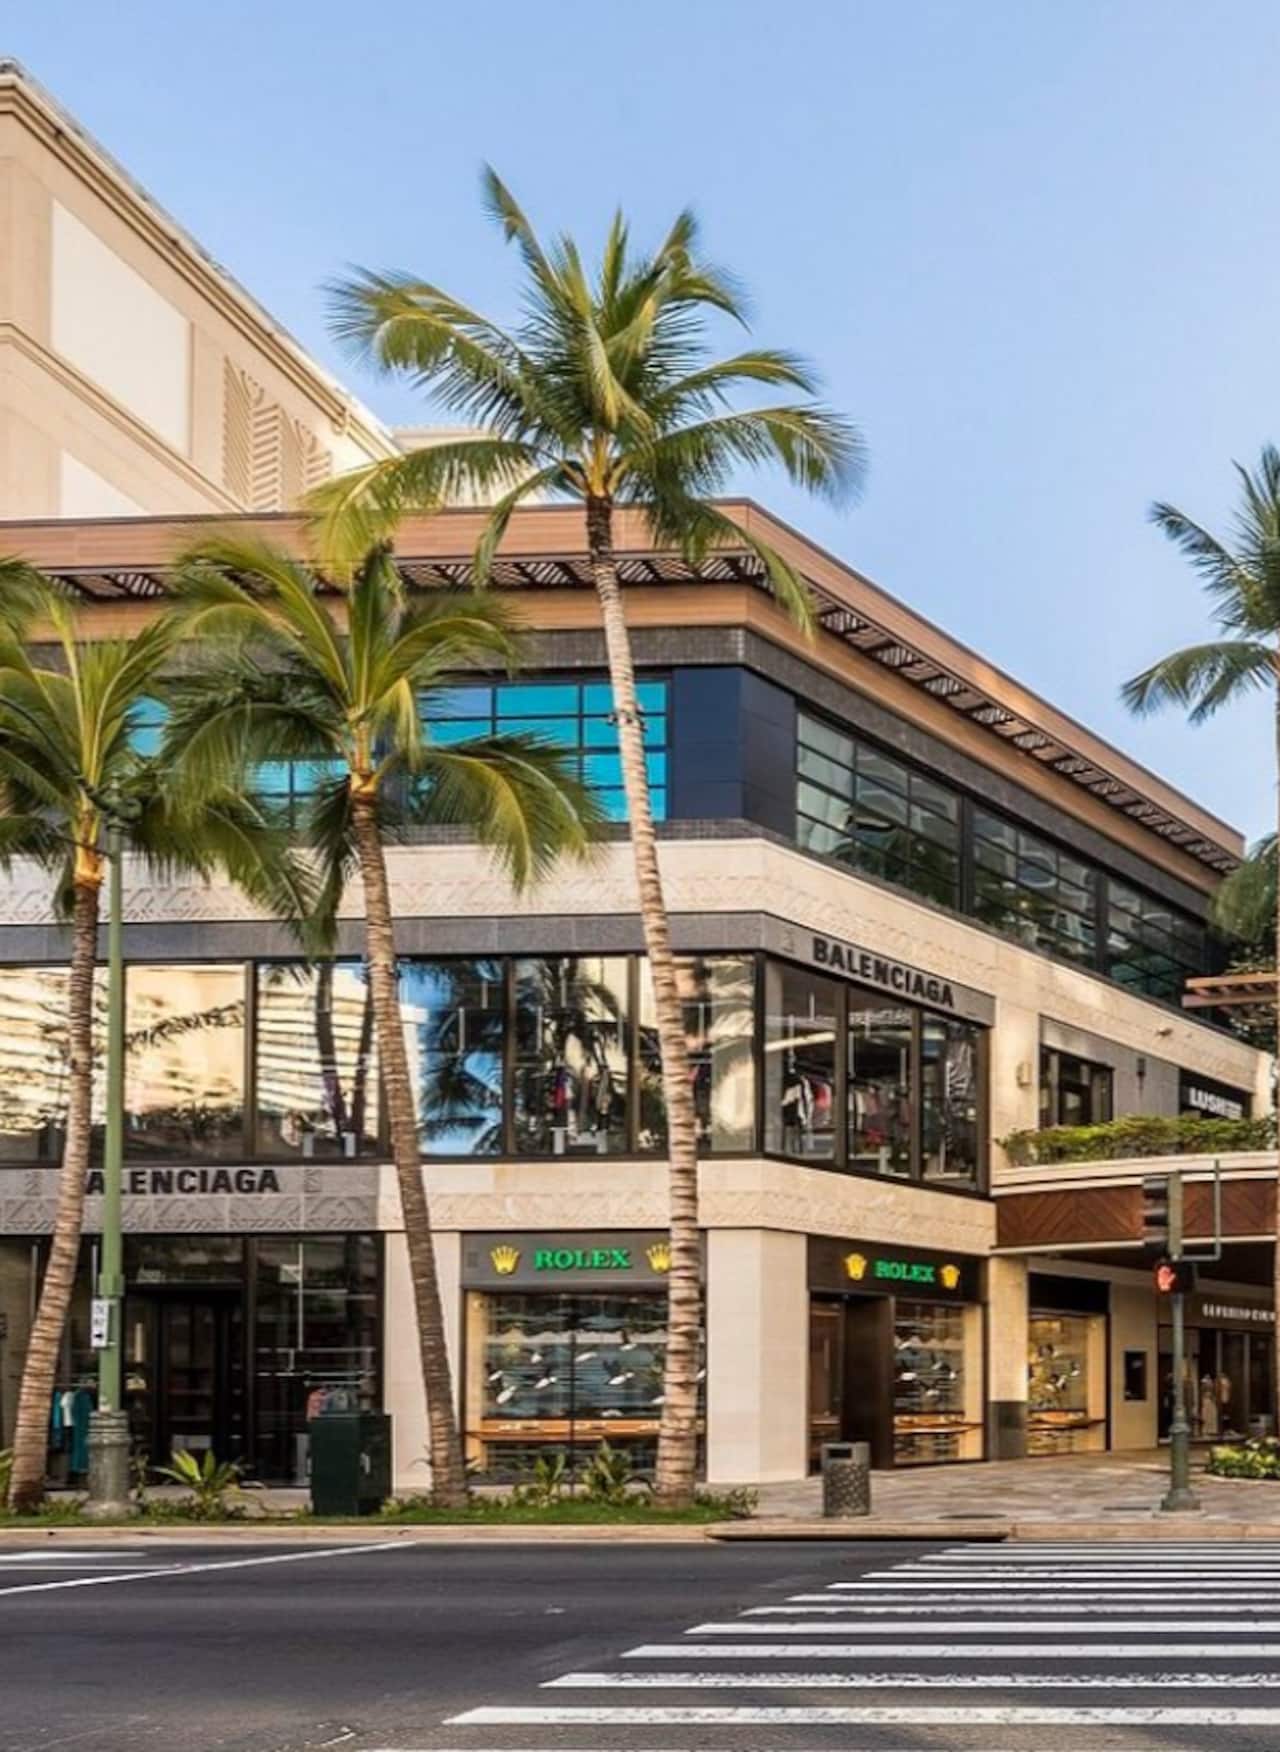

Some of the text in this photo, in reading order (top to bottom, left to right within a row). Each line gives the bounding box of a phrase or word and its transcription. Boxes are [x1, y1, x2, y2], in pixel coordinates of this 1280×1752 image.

[812, 936, 954, 1009] BALENCIAGA
[86, 1169, 281, 1195] AENCIAGA
[534, 1249, 631, 1271] ROLEX
[874, 1259, 935, 1283] ROLEX
